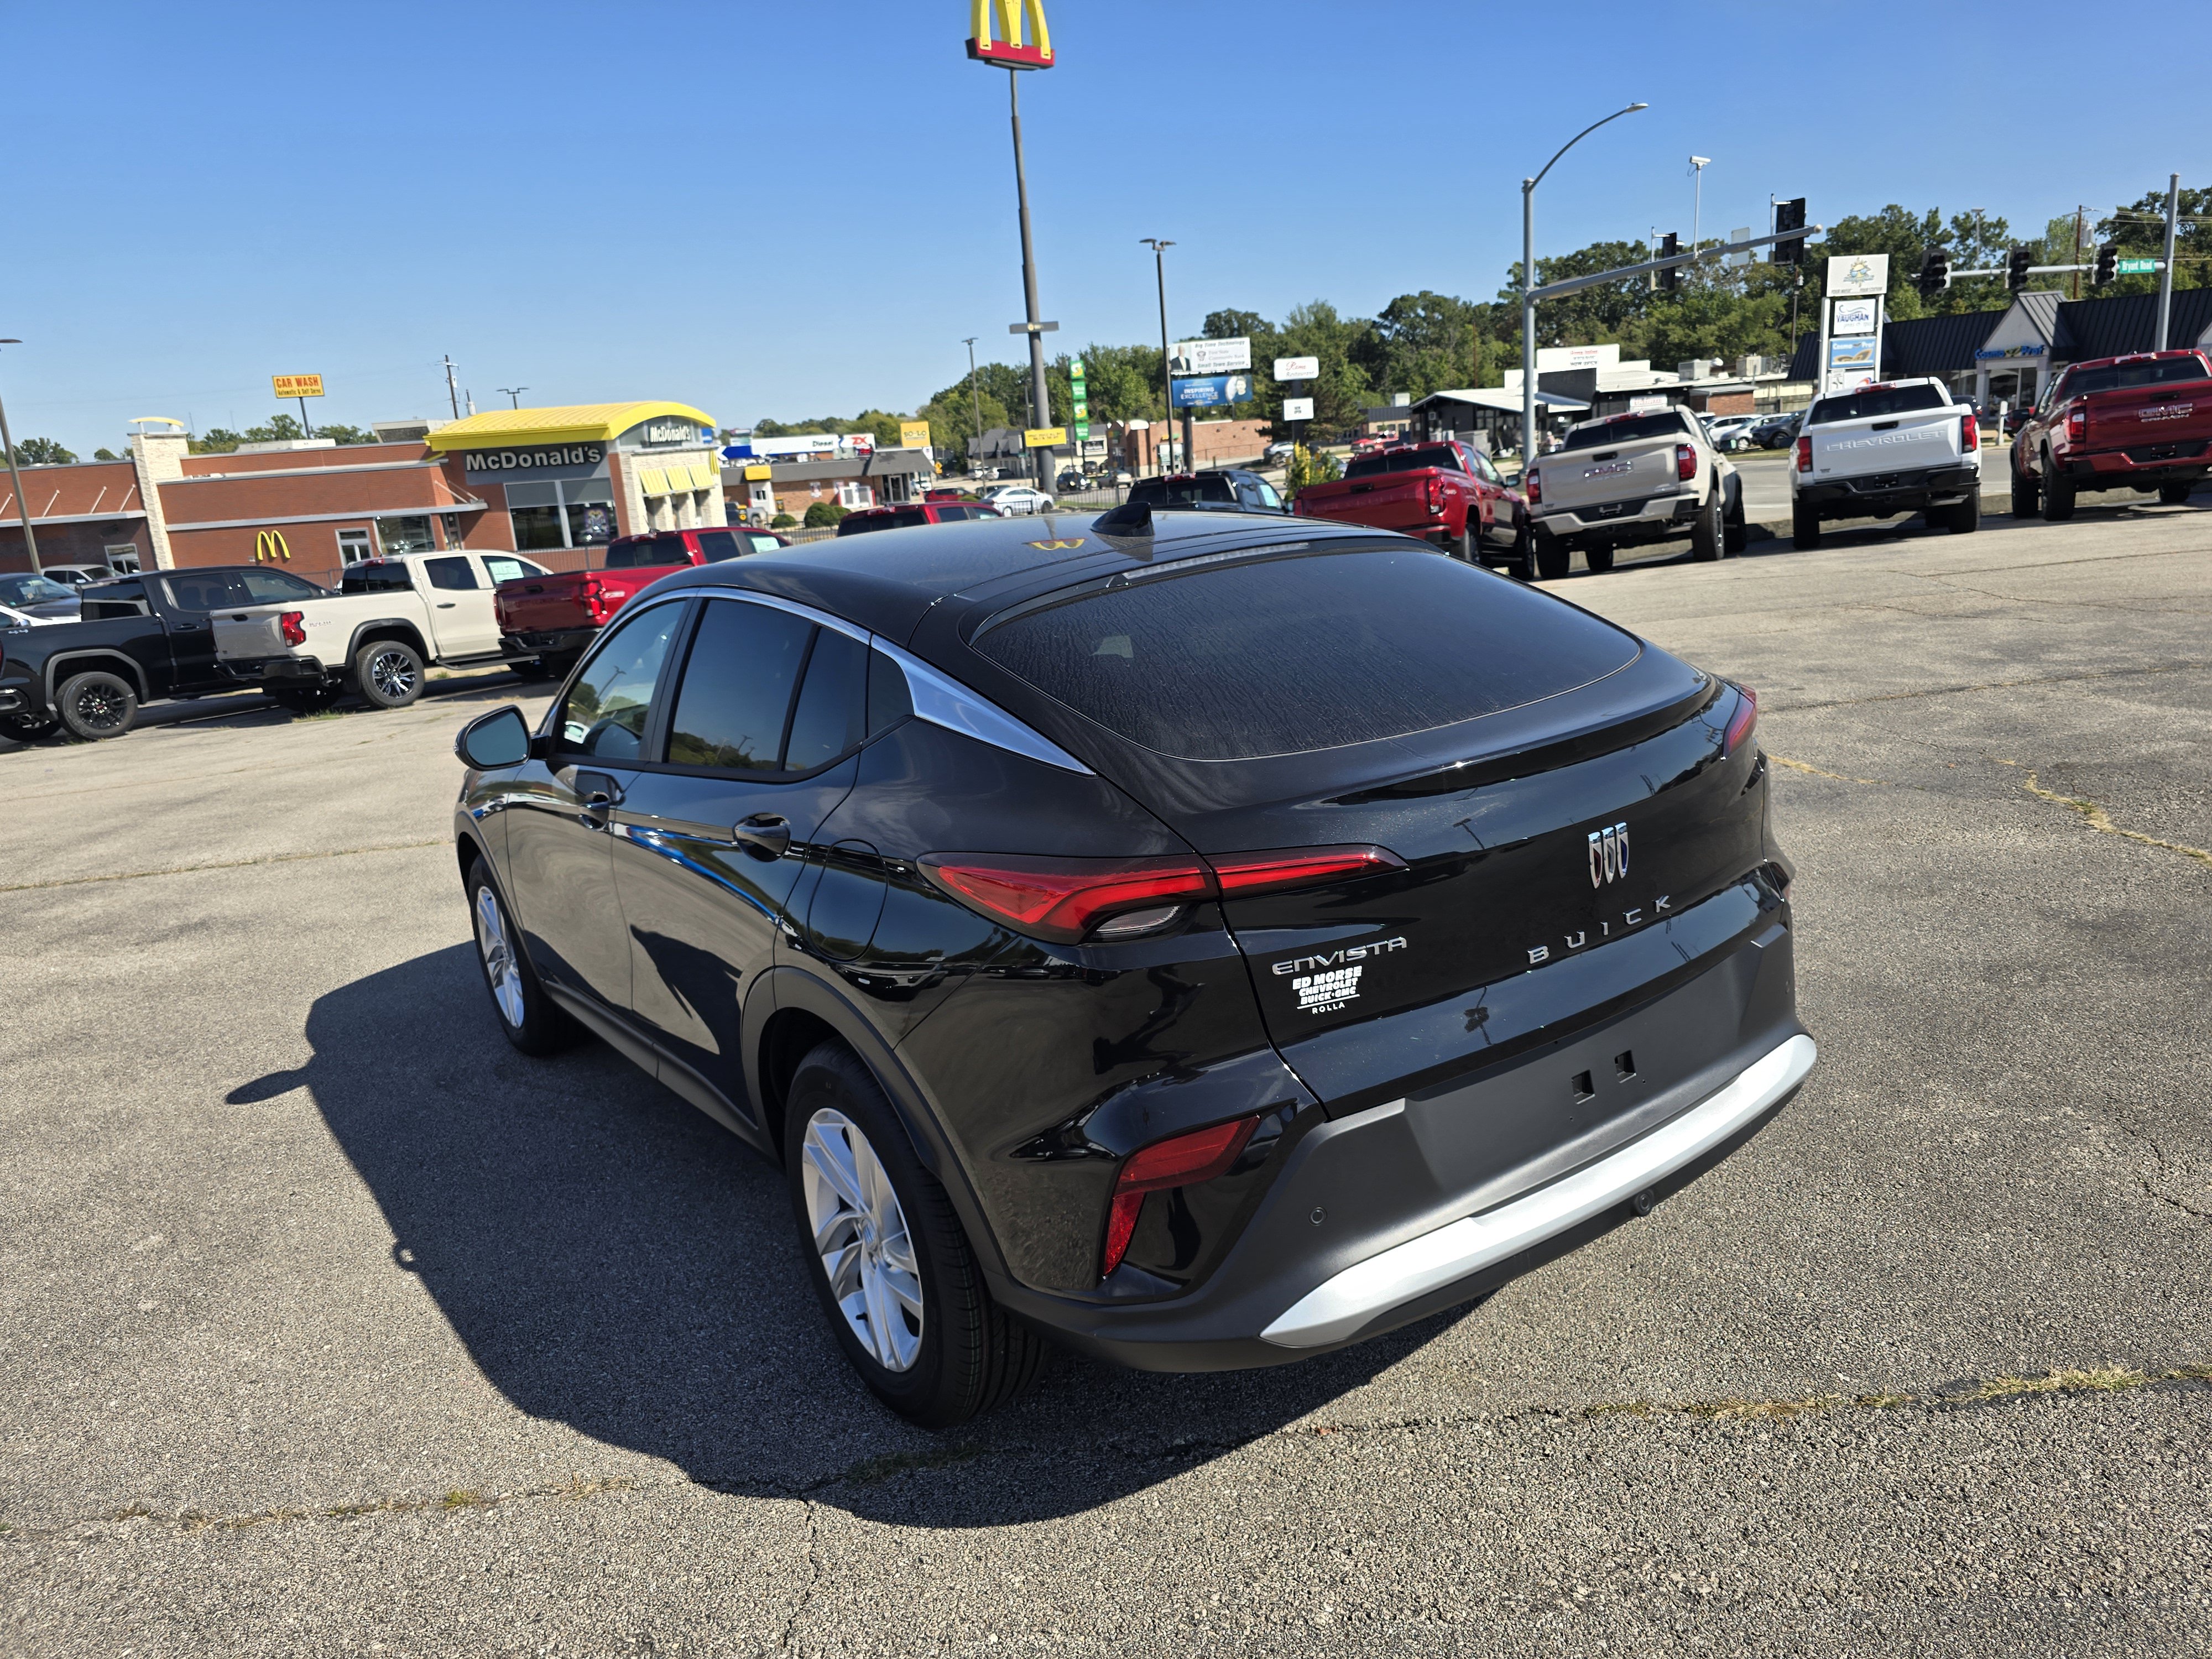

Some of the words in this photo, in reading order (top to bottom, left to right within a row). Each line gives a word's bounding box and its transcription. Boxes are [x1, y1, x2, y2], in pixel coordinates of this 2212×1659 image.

[2122, 261, 2138, 272] Bryant
[2140, 260, 2152, 269] Road
[1837, 313, 1869, 322] VAUGHAN
[1975, 348, 2005, 359] Cosmo
[2021, 345, 2044, 356] Prof
[276, 378, 293, 388] CAR
[295, 377, 319, 387] WASH
[2138, 403, 2193, 418] GMC
[650, 425, 691, 443] McDonald's
[1827, 430, 1946, 452] CHEVROLET
[466, 446, 602, 471] McDonald's
[1527, 895, 1671, 964] BUICK
[1272, 936, 1407, 975] ENVISTA
[1292, 978, 1312, 990] ED
[1313, 965, 1363, 985] MORSE
[1299, 977, 1358, 998] CHEVROLET
[1312, 1001, 1345, 1014] ROLLA
